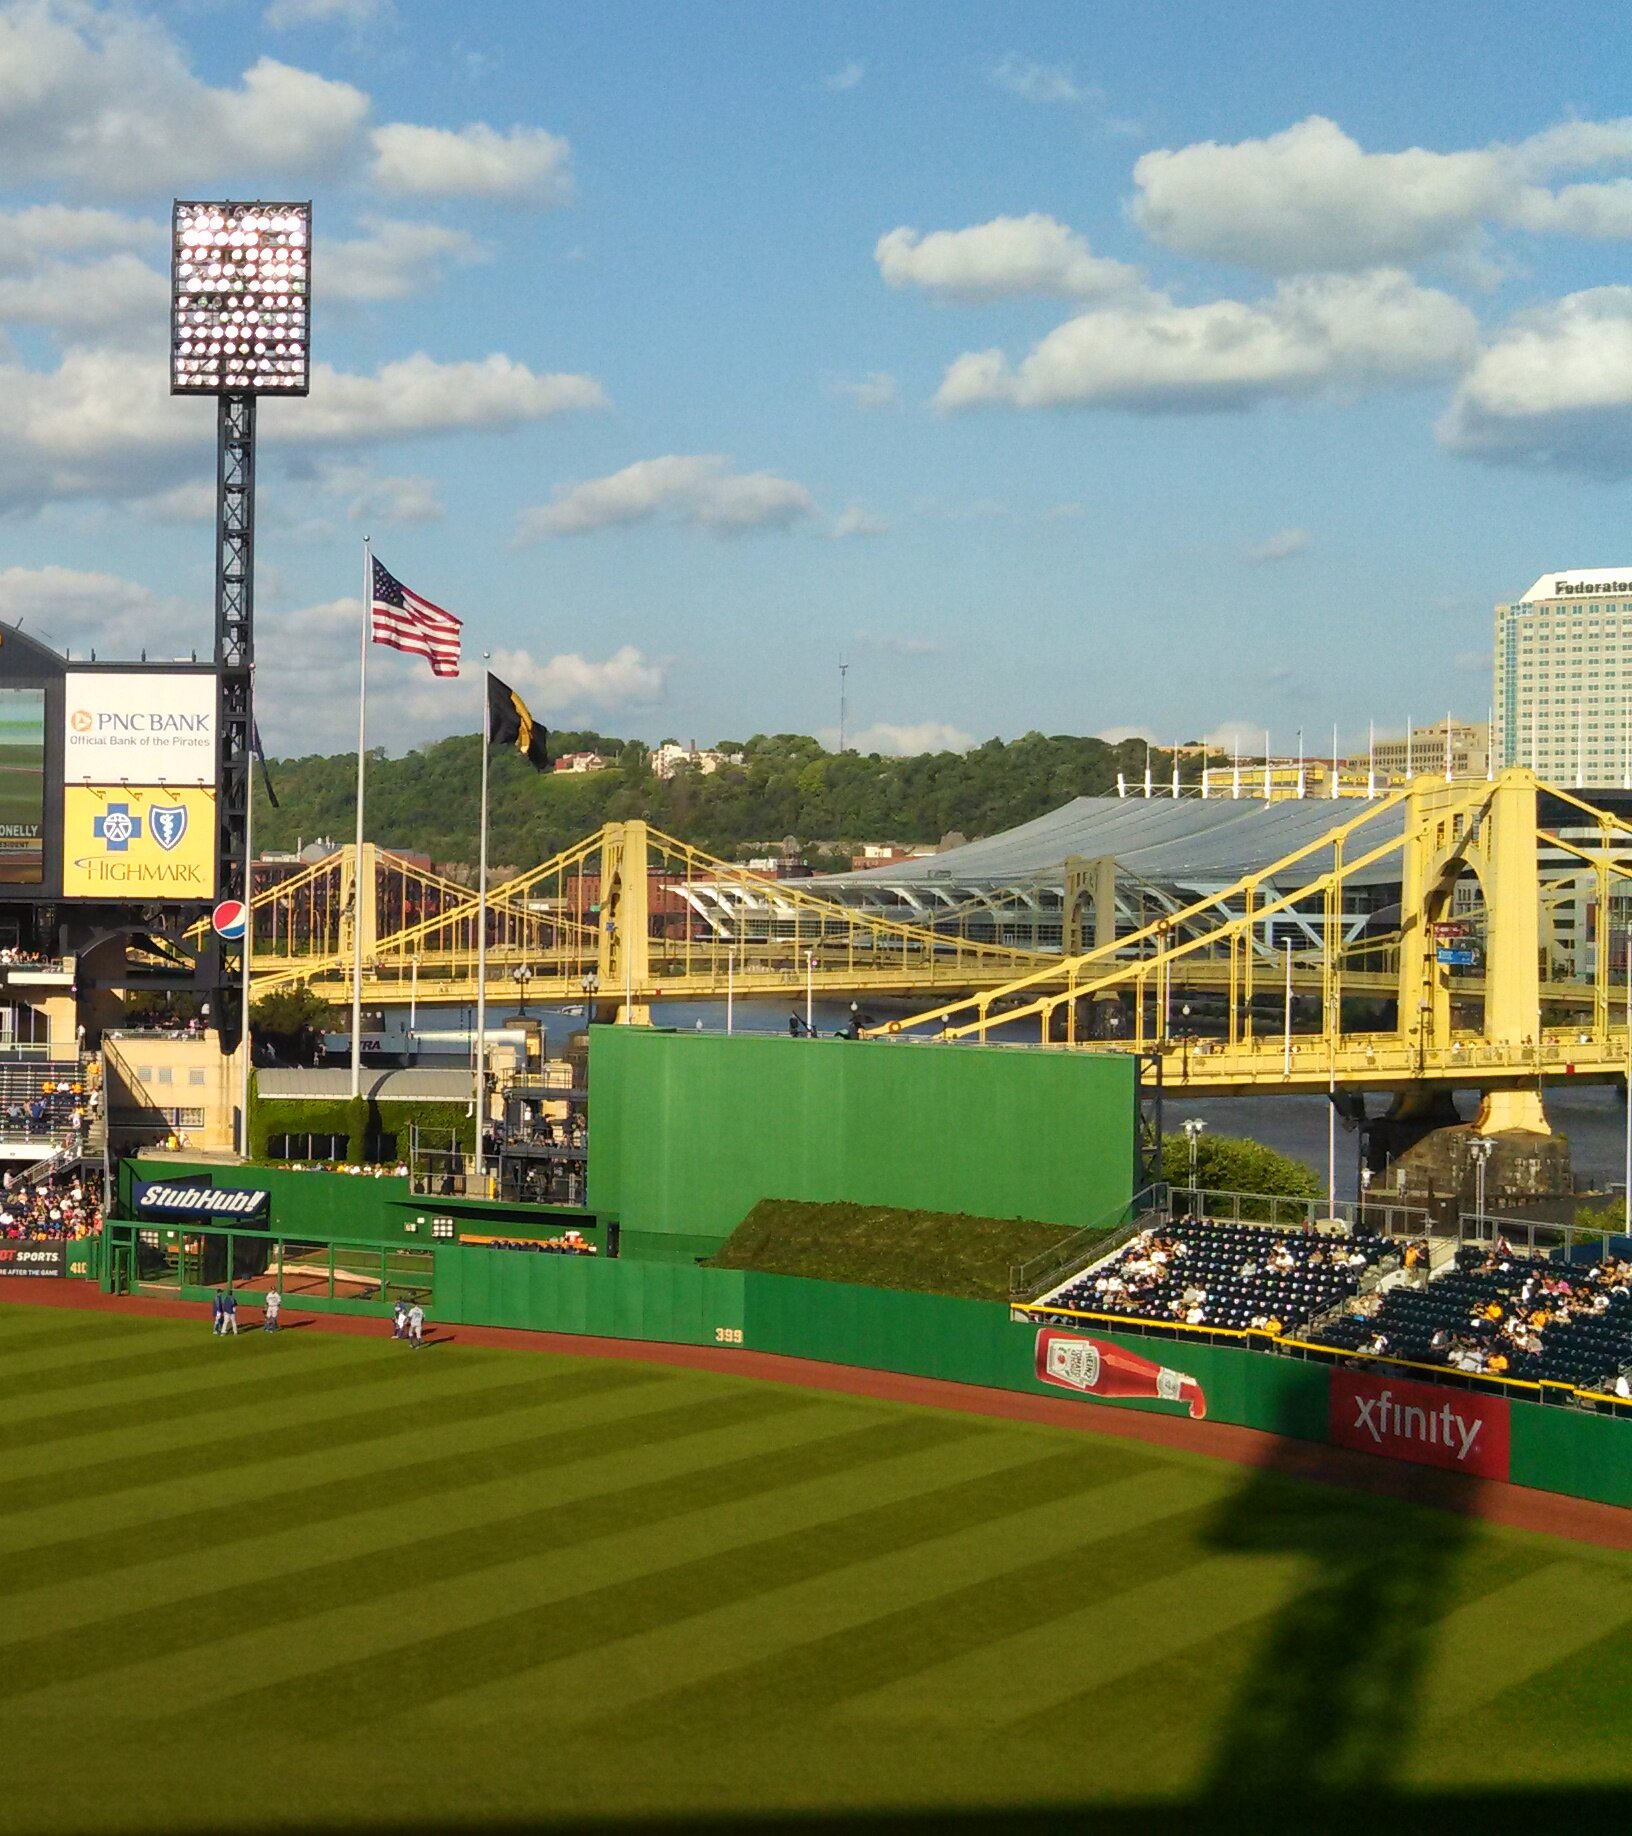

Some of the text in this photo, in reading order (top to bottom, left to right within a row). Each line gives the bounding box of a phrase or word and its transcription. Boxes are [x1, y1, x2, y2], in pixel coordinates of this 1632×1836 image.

[97, 713, 210, 732] PNC BANK
[70, 735, 211, 747] Official Bank of the Pirates
[86, 859, 202, 883] HIGHMARK
[8, 1268, 27, 1276] AFTER
[714, 1327, 744, 1344] 399
[1074, 1349, 1083, 1378] TOMATO
[1084, 1352, 1094, 1379] HEINZ
[1353, 1390, 1483, 1461] xfinity
